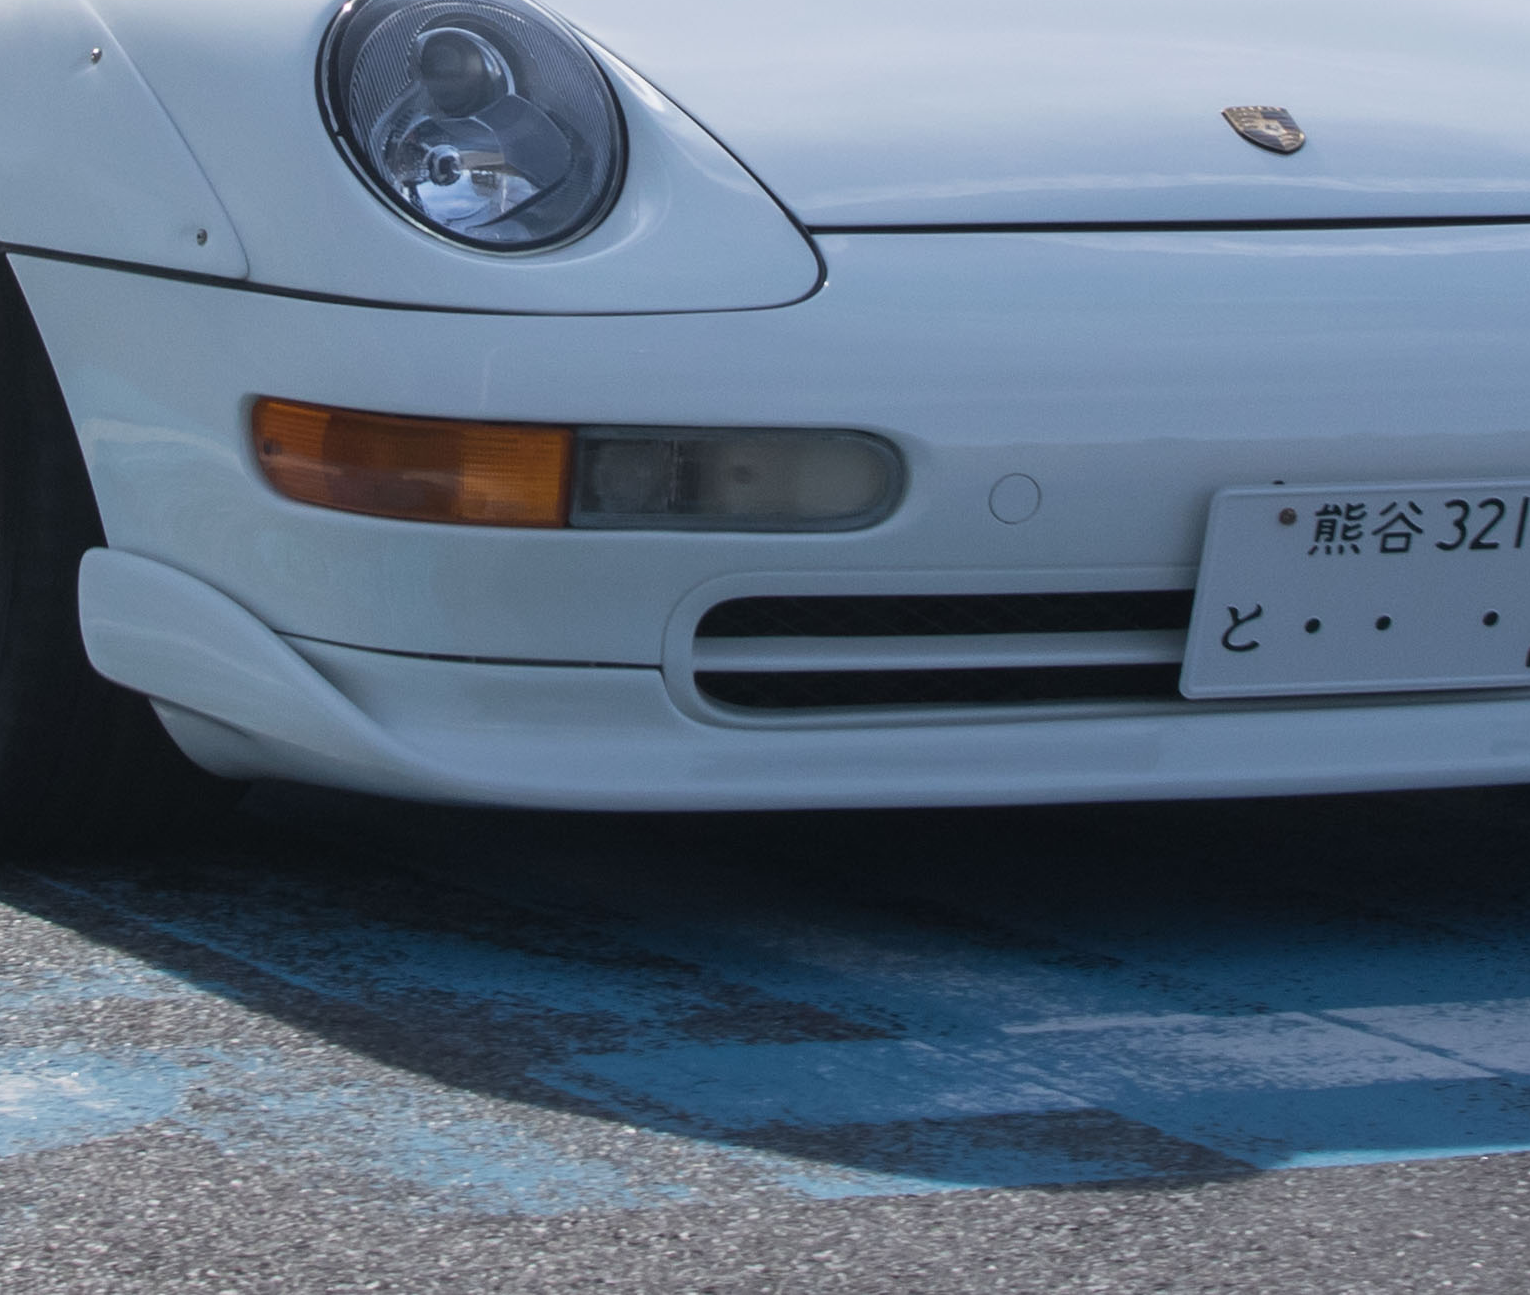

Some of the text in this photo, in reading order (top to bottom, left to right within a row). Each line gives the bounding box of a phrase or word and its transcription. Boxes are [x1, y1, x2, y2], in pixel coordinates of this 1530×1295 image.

[1308, 496, 1530, 555] 熊谷 321
[1221, 603, 1262, 652] と
